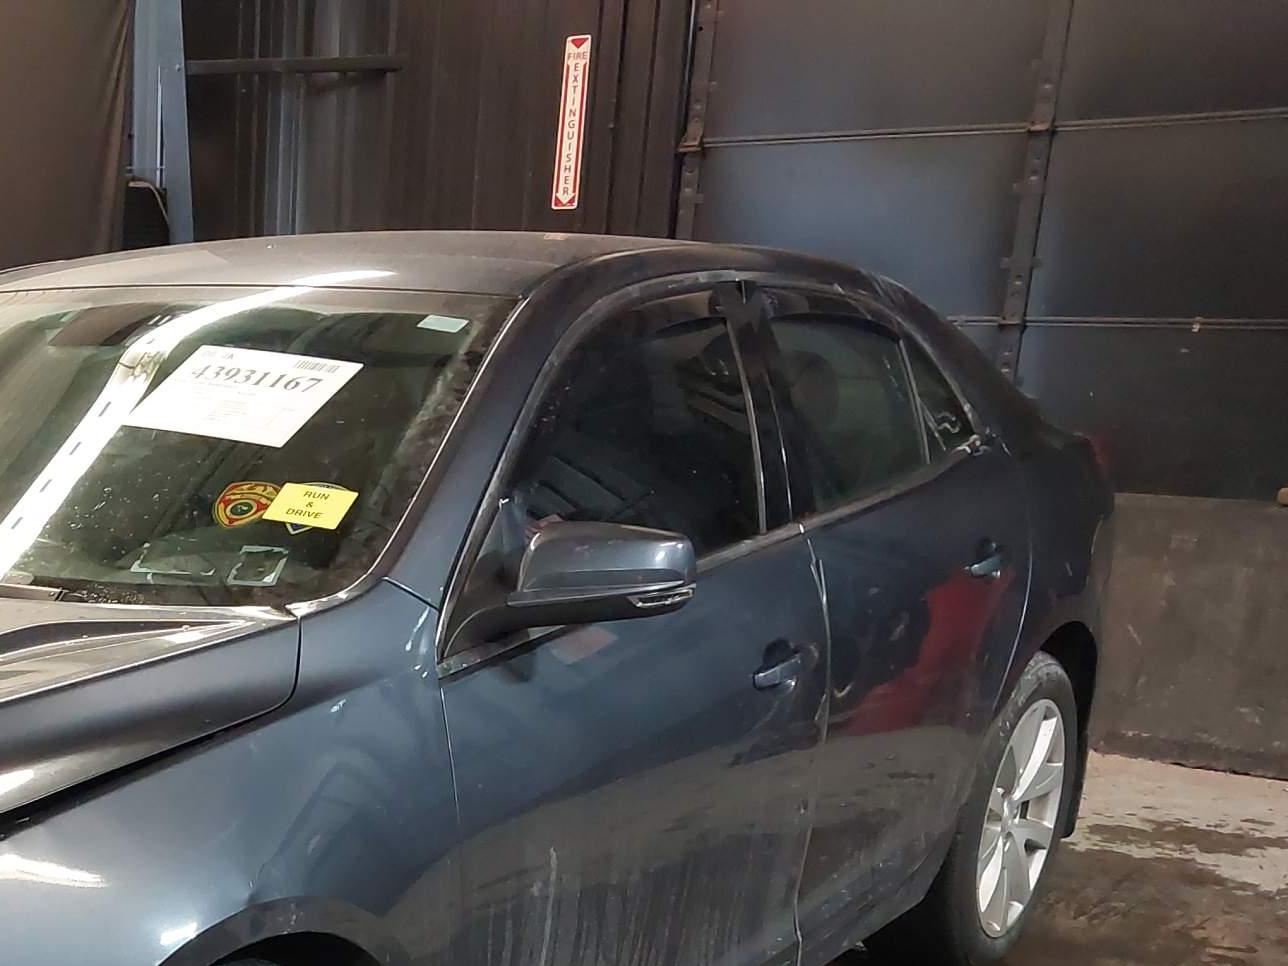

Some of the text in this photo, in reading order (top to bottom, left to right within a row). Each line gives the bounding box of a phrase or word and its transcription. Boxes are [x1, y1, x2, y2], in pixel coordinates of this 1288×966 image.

[567, 51, 588, 60] FIRE
[562, 62, 580, 196] EXTINGUISHER
[191, 364, 323, 393] 43931167
[303, 490, 330, 500] RUN
[285, 508, 324, 519] DRIVE
